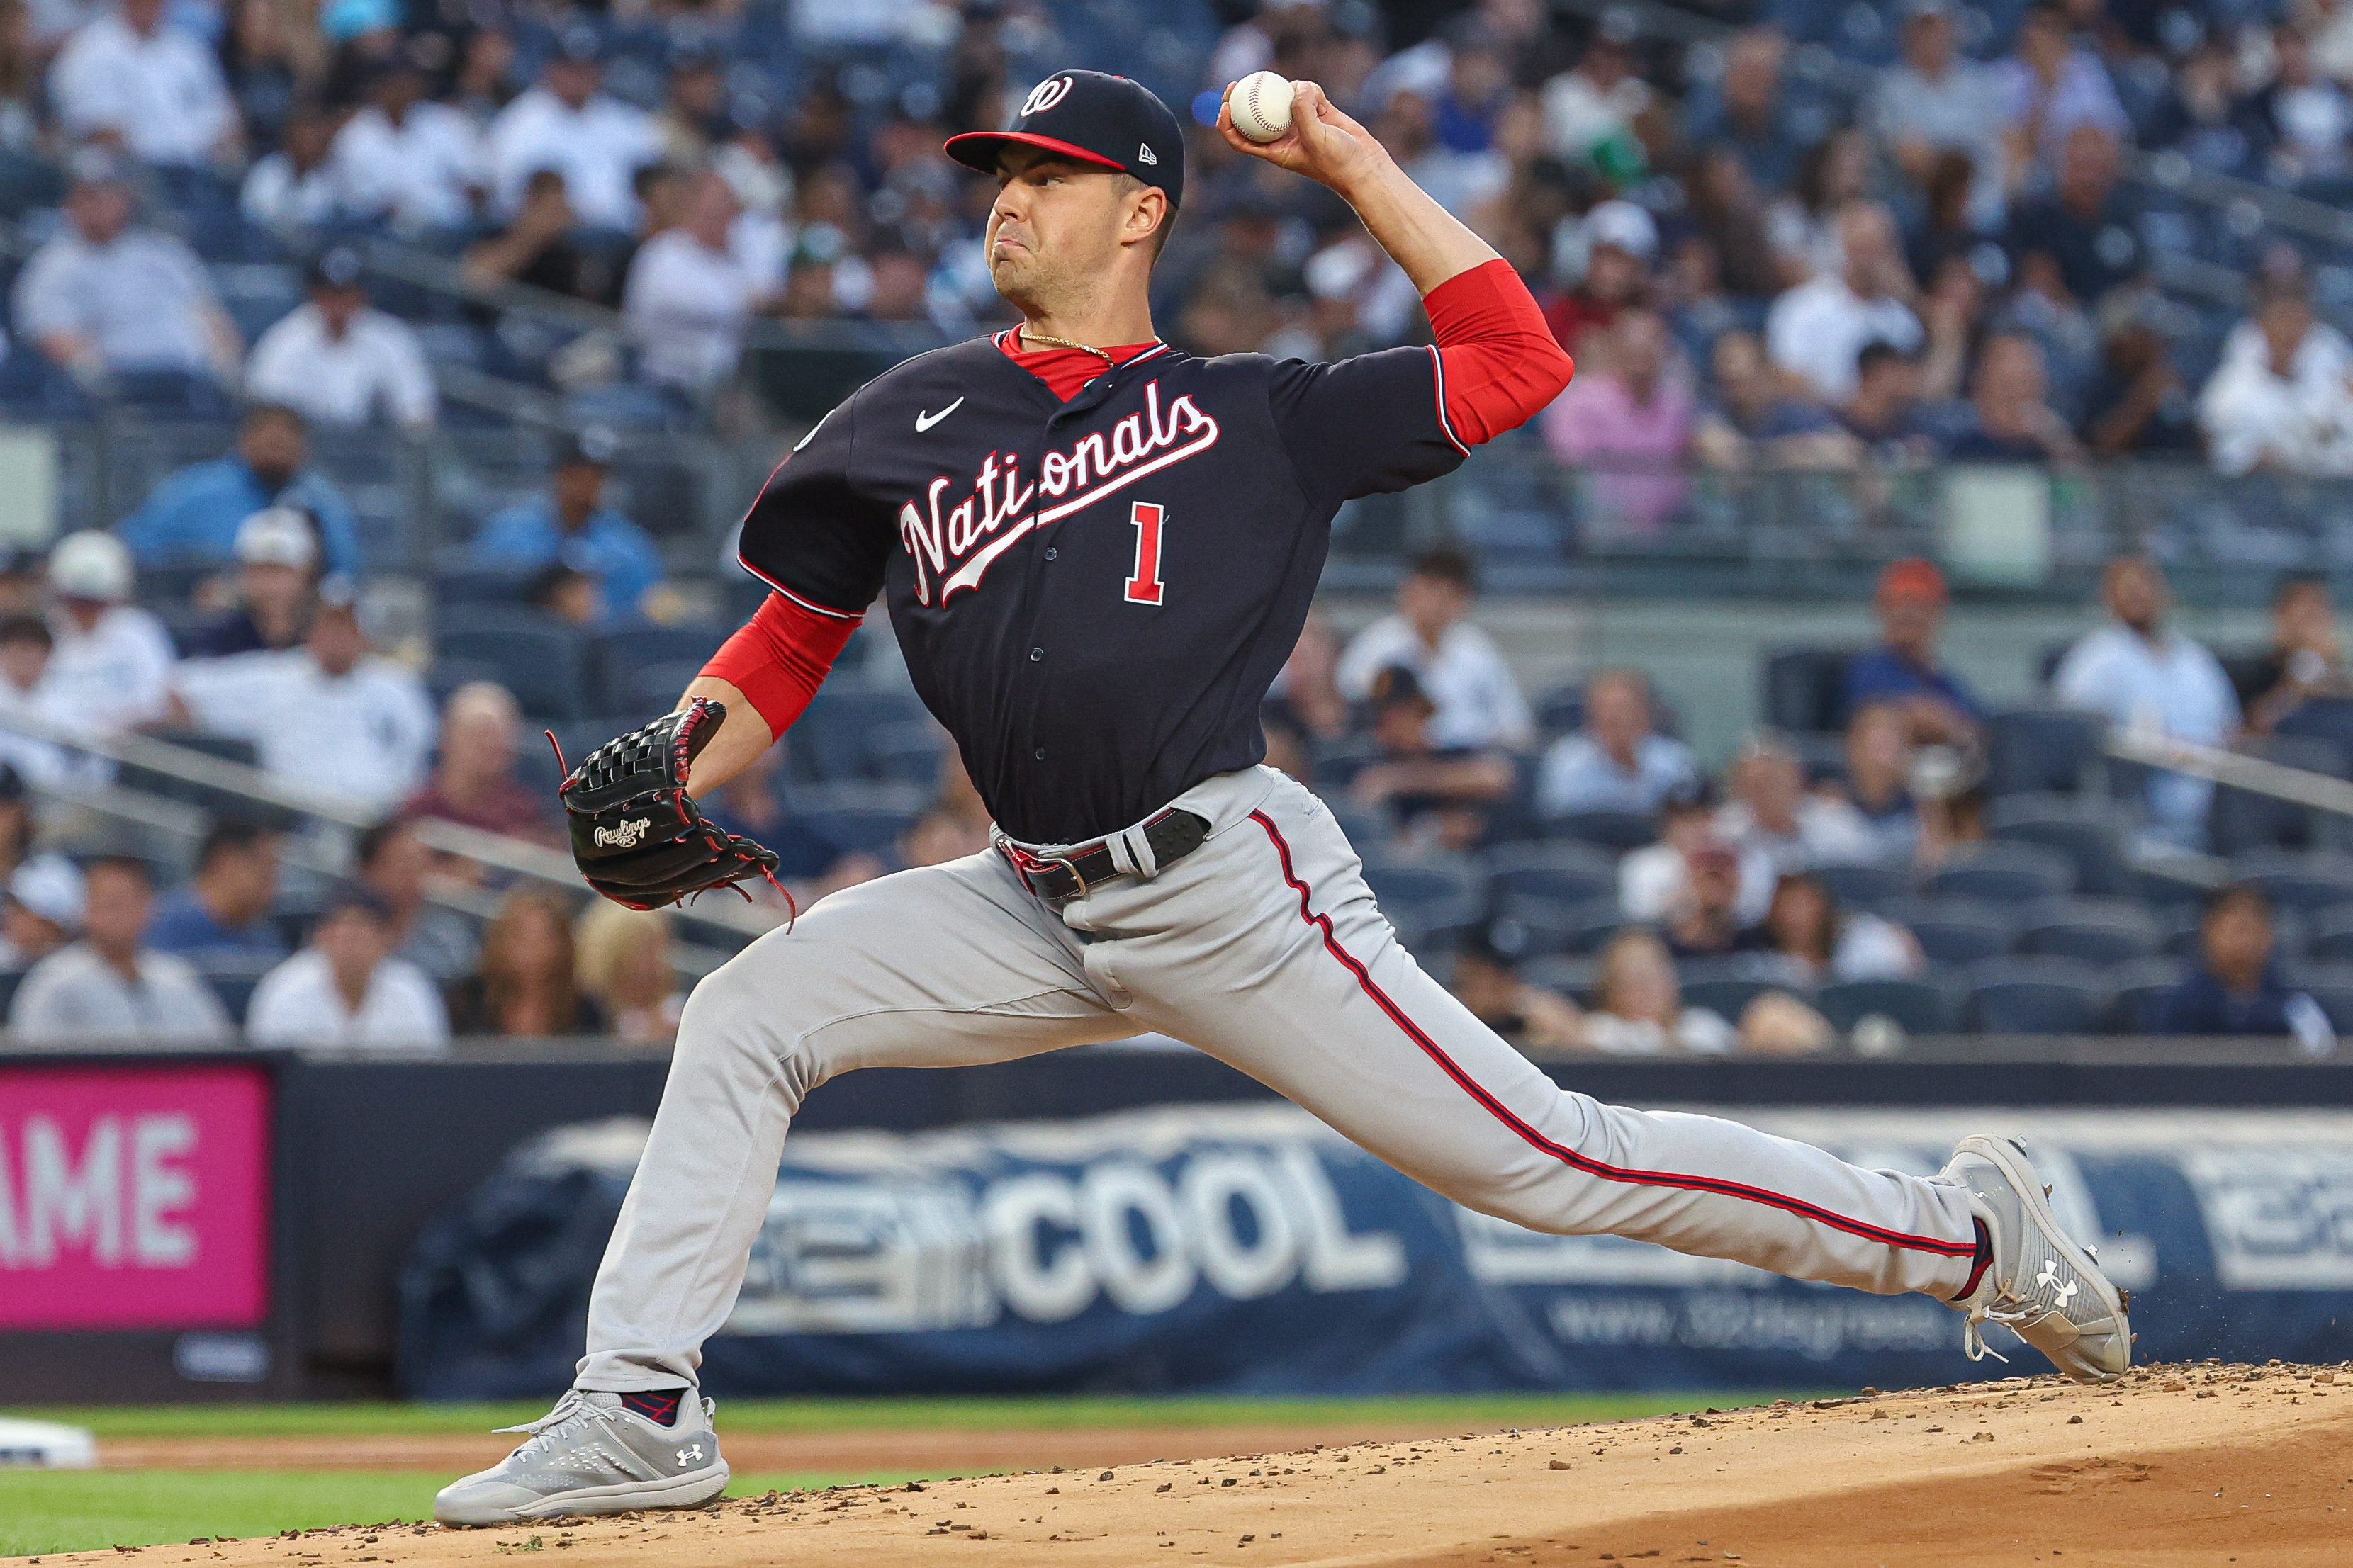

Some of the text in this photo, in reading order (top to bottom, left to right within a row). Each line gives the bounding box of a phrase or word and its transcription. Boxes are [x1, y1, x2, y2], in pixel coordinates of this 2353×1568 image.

[900, 378, 1221, 609] Nationals
[1125, 501, 1164, 607] 1
[594, 817, 651, 847] Rawlings
[991, 1143, 1407, 1322] COOL
